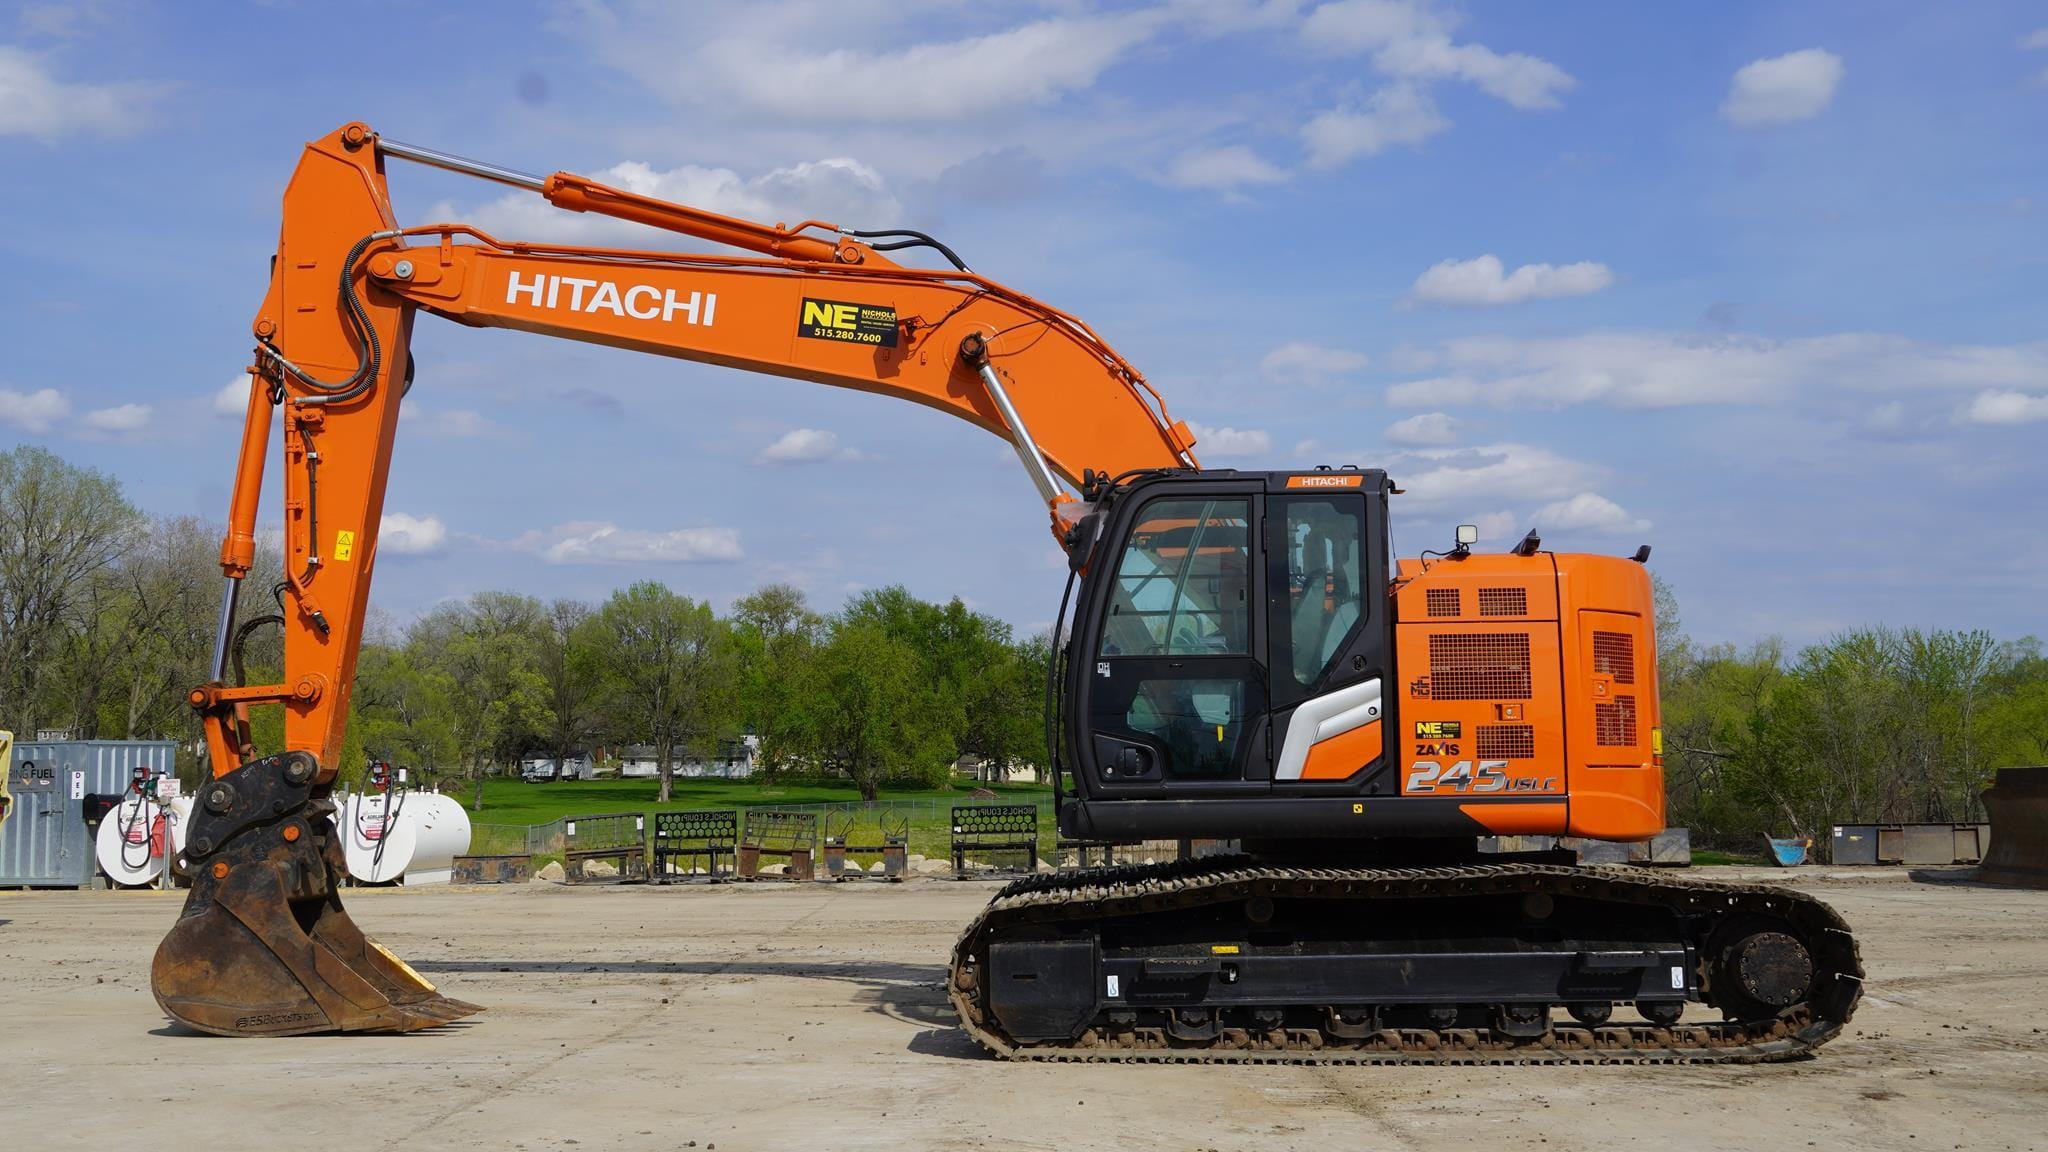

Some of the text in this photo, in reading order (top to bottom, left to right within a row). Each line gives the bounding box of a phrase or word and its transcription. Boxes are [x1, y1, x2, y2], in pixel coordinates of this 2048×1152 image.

[506, 271, 716, 327] HITACHI
[803, 301, 858, 330] NE
[862, 309, 896, 319] NICHOLS
[814, 328, 881, 343] 515.280.7600
[1302, 477, 1347, 486] HITACHI
[1417, 722, 1442, 734] NE
[1416, 742, 1459, 756] ZAXIS
[31, 768, 54, 778] FUEL
